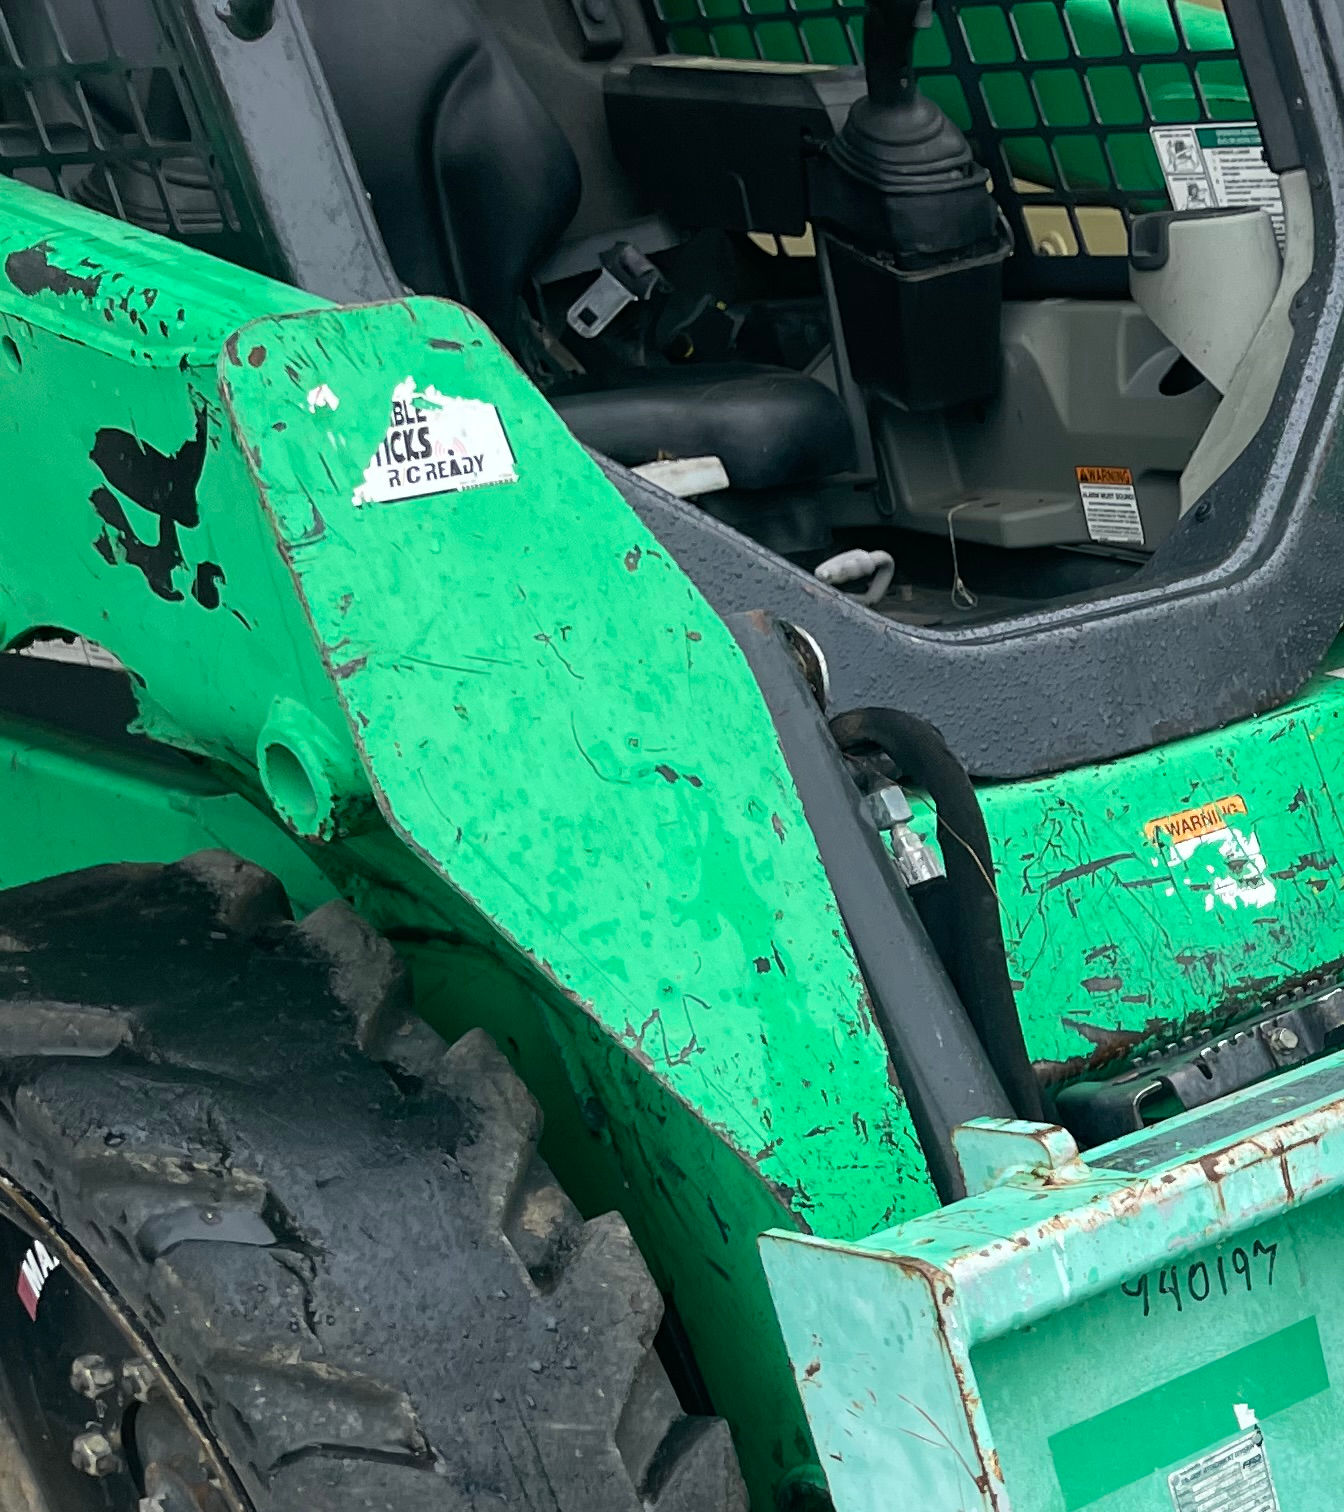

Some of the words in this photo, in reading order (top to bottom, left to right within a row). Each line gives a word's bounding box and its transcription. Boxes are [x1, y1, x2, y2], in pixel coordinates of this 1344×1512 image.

[390, 399, 427, 427] BLE
[425, 453, 484, 482] READY
[21, 1240, 60, 1299] MA
